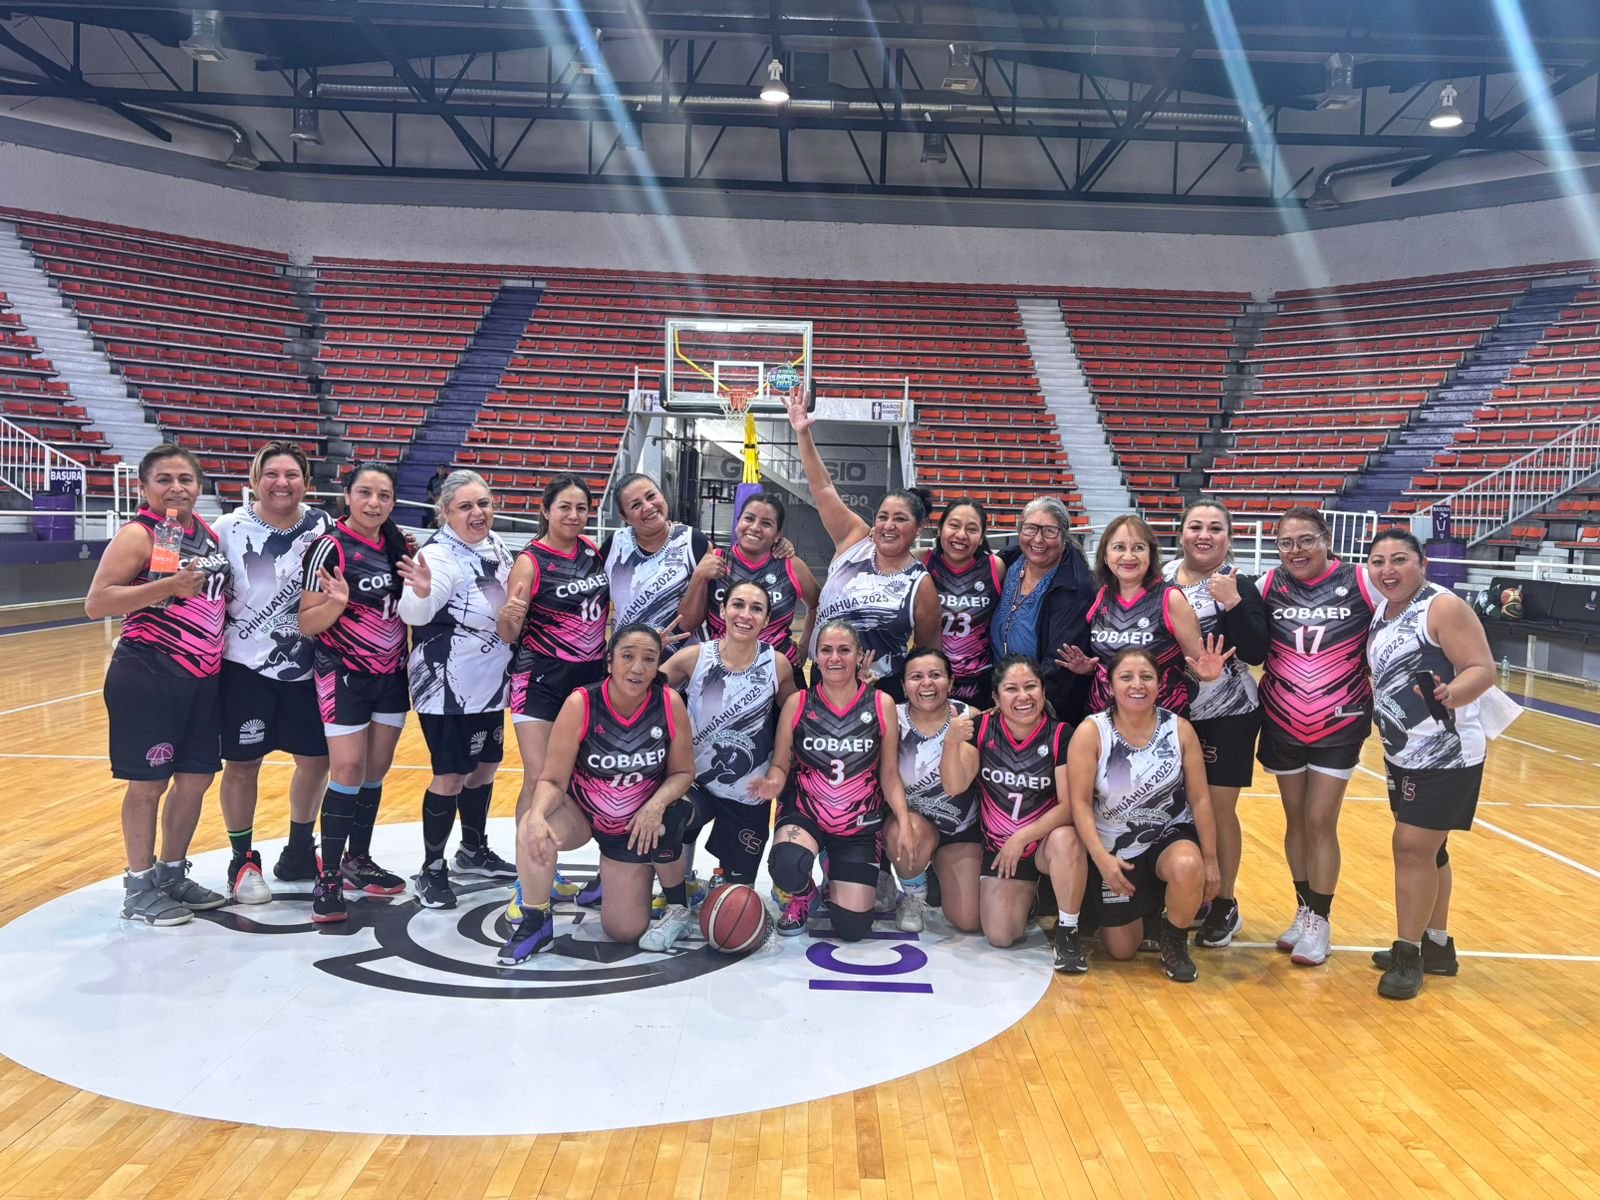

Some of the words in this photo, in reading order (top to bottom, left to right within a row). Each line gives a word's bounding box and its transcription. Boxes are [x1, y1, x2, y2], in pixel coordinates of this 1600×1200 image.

[50, 471, 82, 480] BASURA
[206, 572, 225, 602] 12
[941, 612, 972, 638] 23
[1272, 607, 1351, 621] COBAEP
[1091, 630, 1154, 646] COBAEP
[1292, 625, 1327, 655] 17
[803, 737, 874, 752] COBAEP
[587, 748, 666, 769] COBAEP
[828, 759, 846, 786] 3
[981, 767, 1051, 790] COBAEP
[1007, 792, 1023, 821] 7
